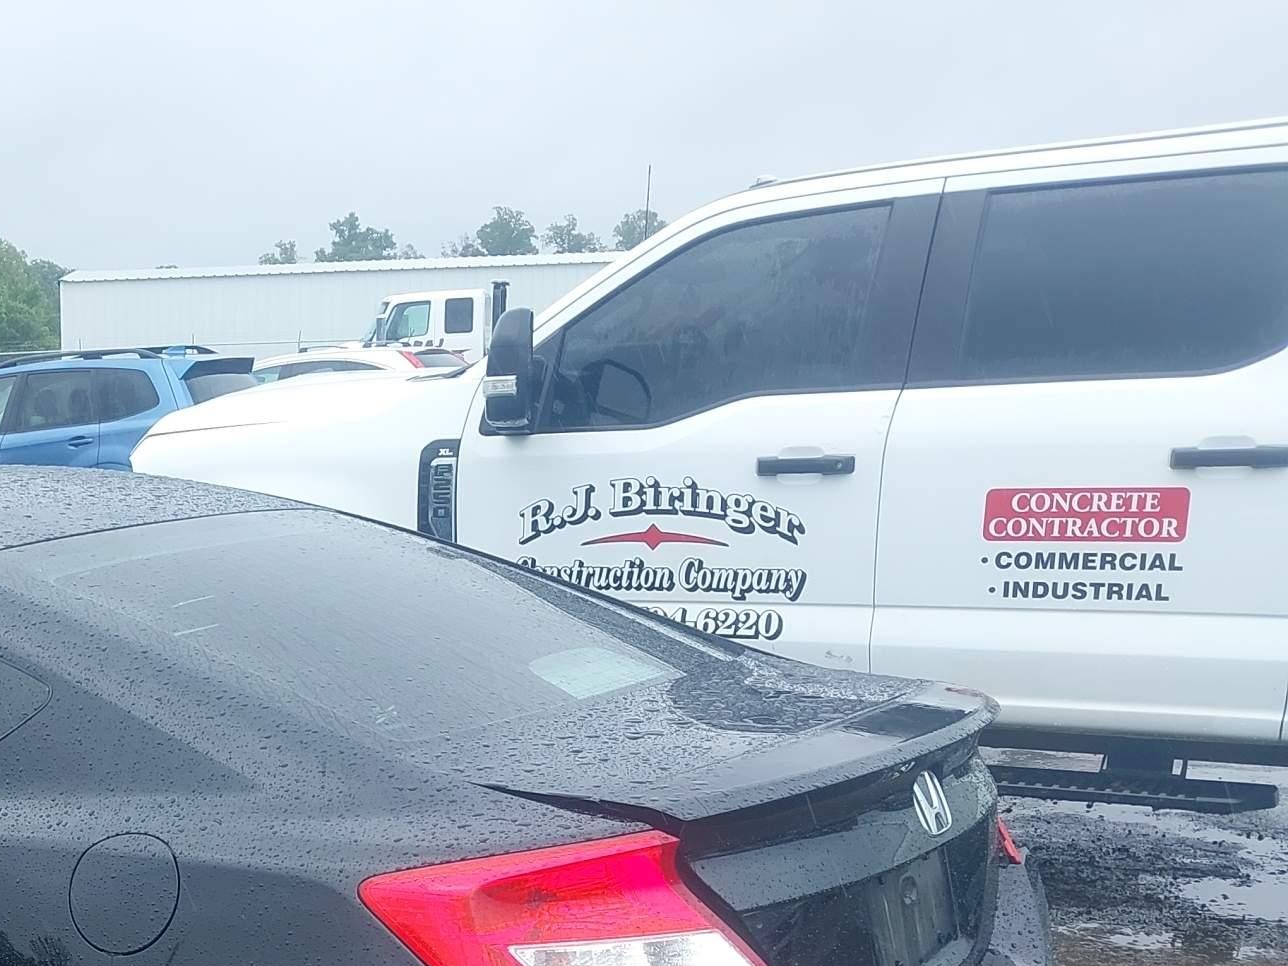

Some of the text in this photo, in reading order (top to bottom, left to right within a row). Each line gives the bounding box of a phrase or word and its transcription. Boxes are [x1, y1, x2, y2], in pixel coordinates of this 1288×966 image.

[438, 448, 454, 456] XL
[518, 476, 806, 546] R.J. Biringer
[1011, 492, 1161, 513] CONCRETE
[988, 517, 1180, 538] CONTRACTOR
[994, 551, 1184, 571] COMMERCIAL
[679, 557, 807, 601] Company
[1002, 581, 1170, 601] INDUSTRIAL
